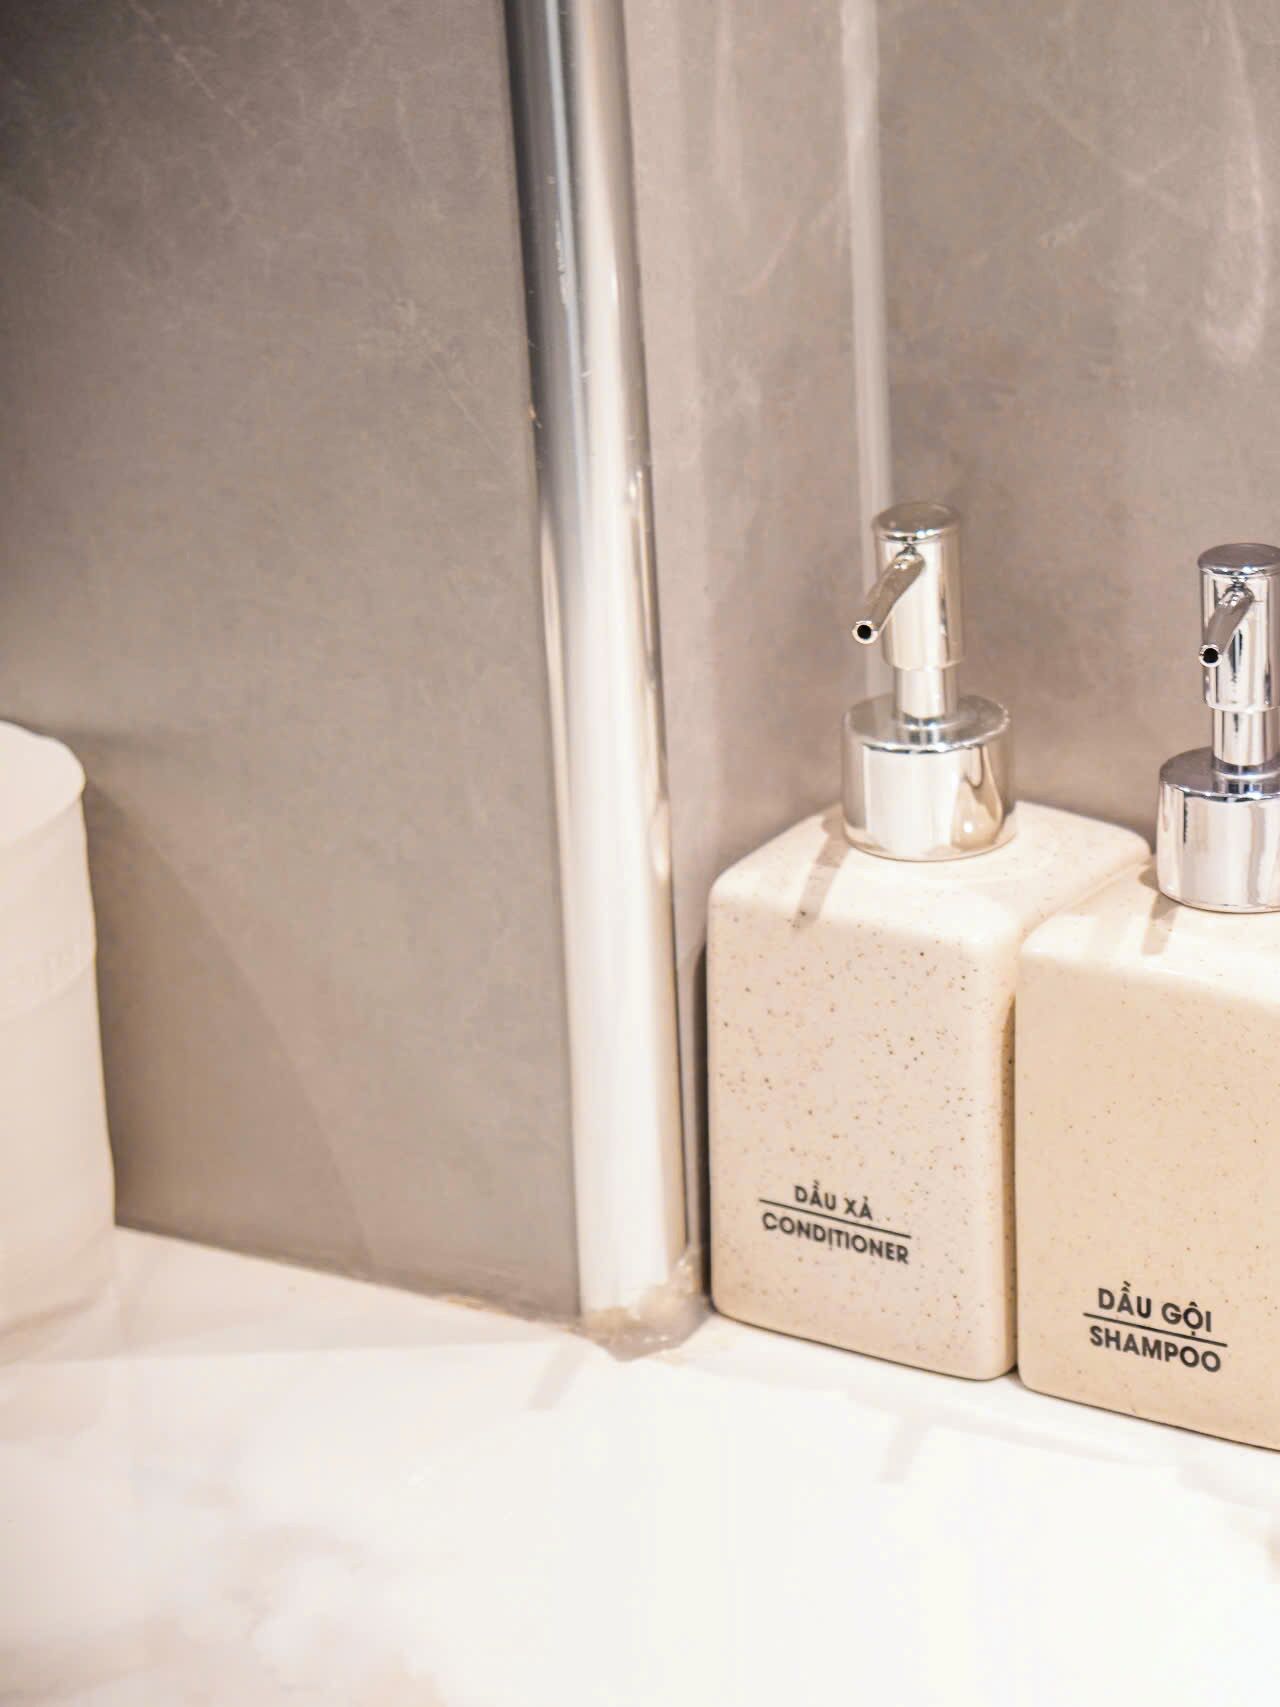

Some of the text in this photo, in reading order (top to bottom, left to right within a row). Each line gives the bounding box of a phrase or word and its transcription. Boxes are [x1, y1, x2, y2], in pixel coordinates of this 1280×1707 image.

[794, 1180, 873, 1220] DẦU XẢ
[762, 1212, 909, 1264] CONDITIONER
[1098, 1281, 1211, 1336] DẦU GỘI
[1090, 1326, 1221, 1372] SHAMPOO
